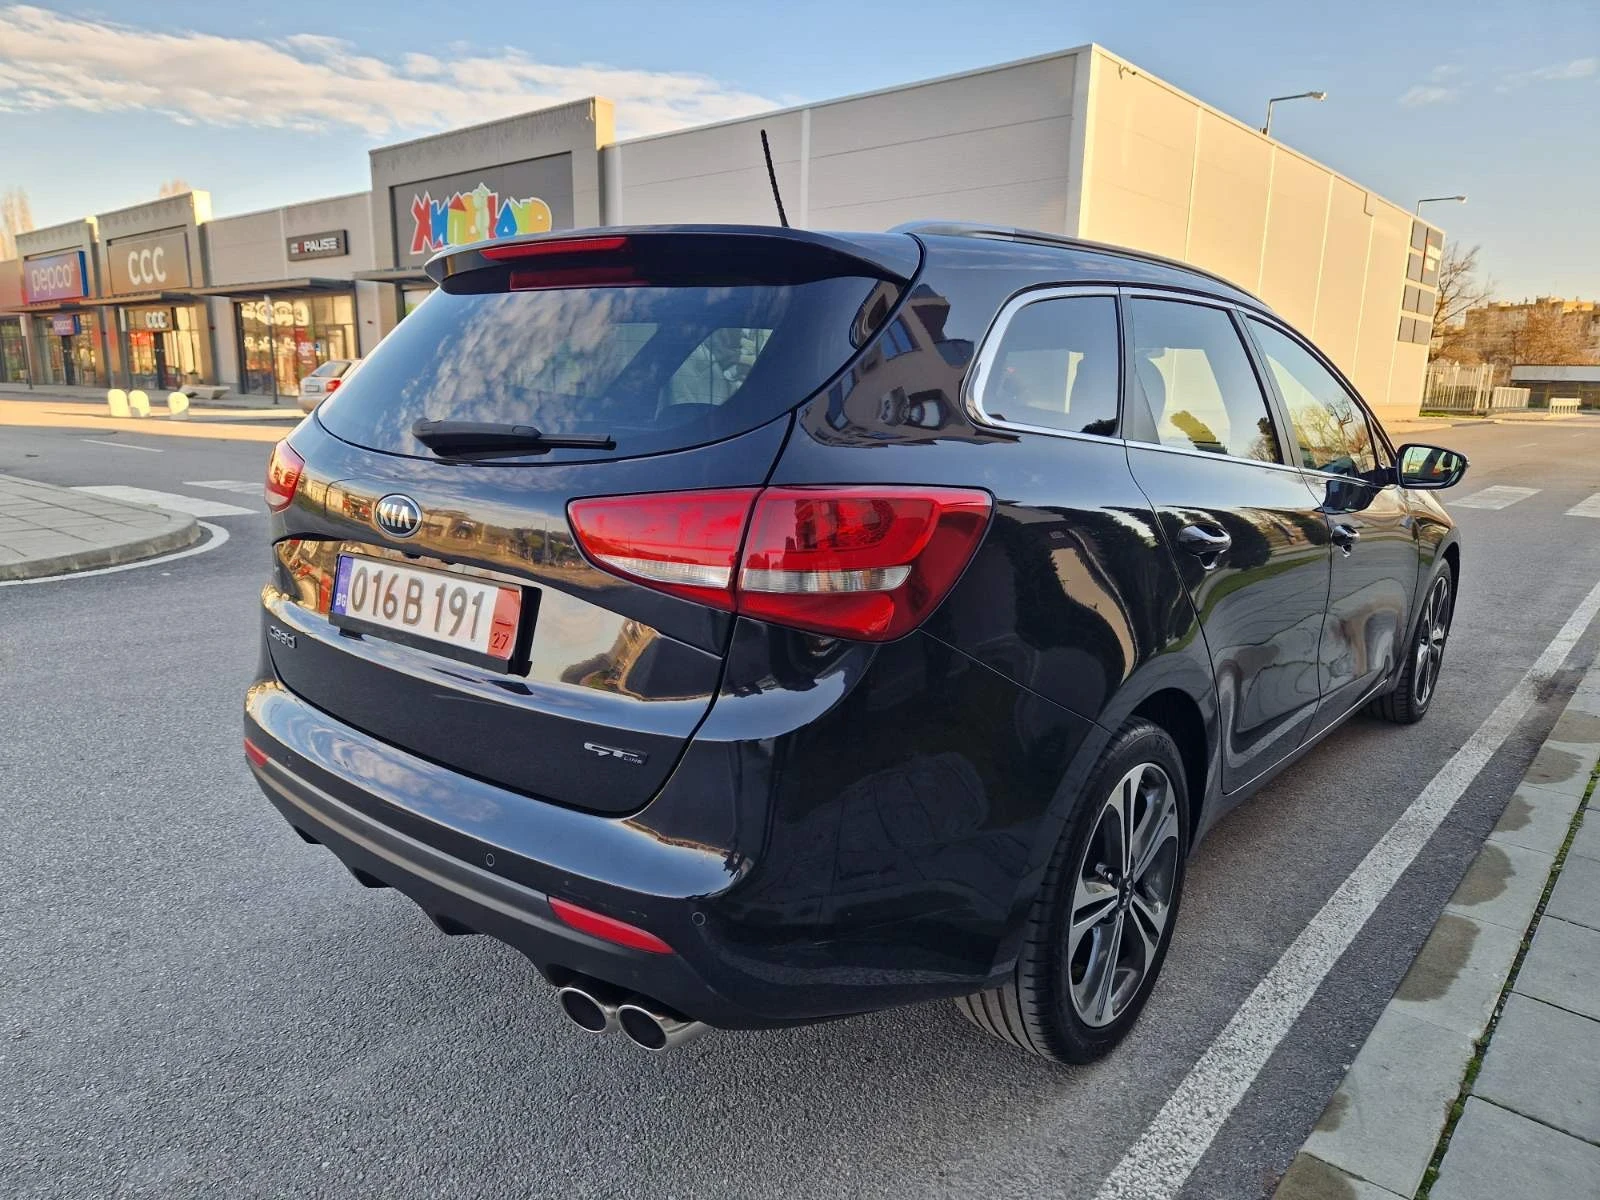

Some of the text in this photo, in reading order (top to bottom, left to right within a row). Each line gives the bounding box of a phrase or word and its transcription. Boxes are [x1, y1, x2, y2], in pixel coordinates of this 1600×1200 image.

[303, 237, 337, 252] PAUSE
[127, 246, 167, 286] CCC
[31, 263, 73, 297] pepco
[145, 311, 168, 328] CCC
[379, 502, 412, 530] KIA
[335, 592, 348, 607] BG
[491, 631, 510, 650] 27
